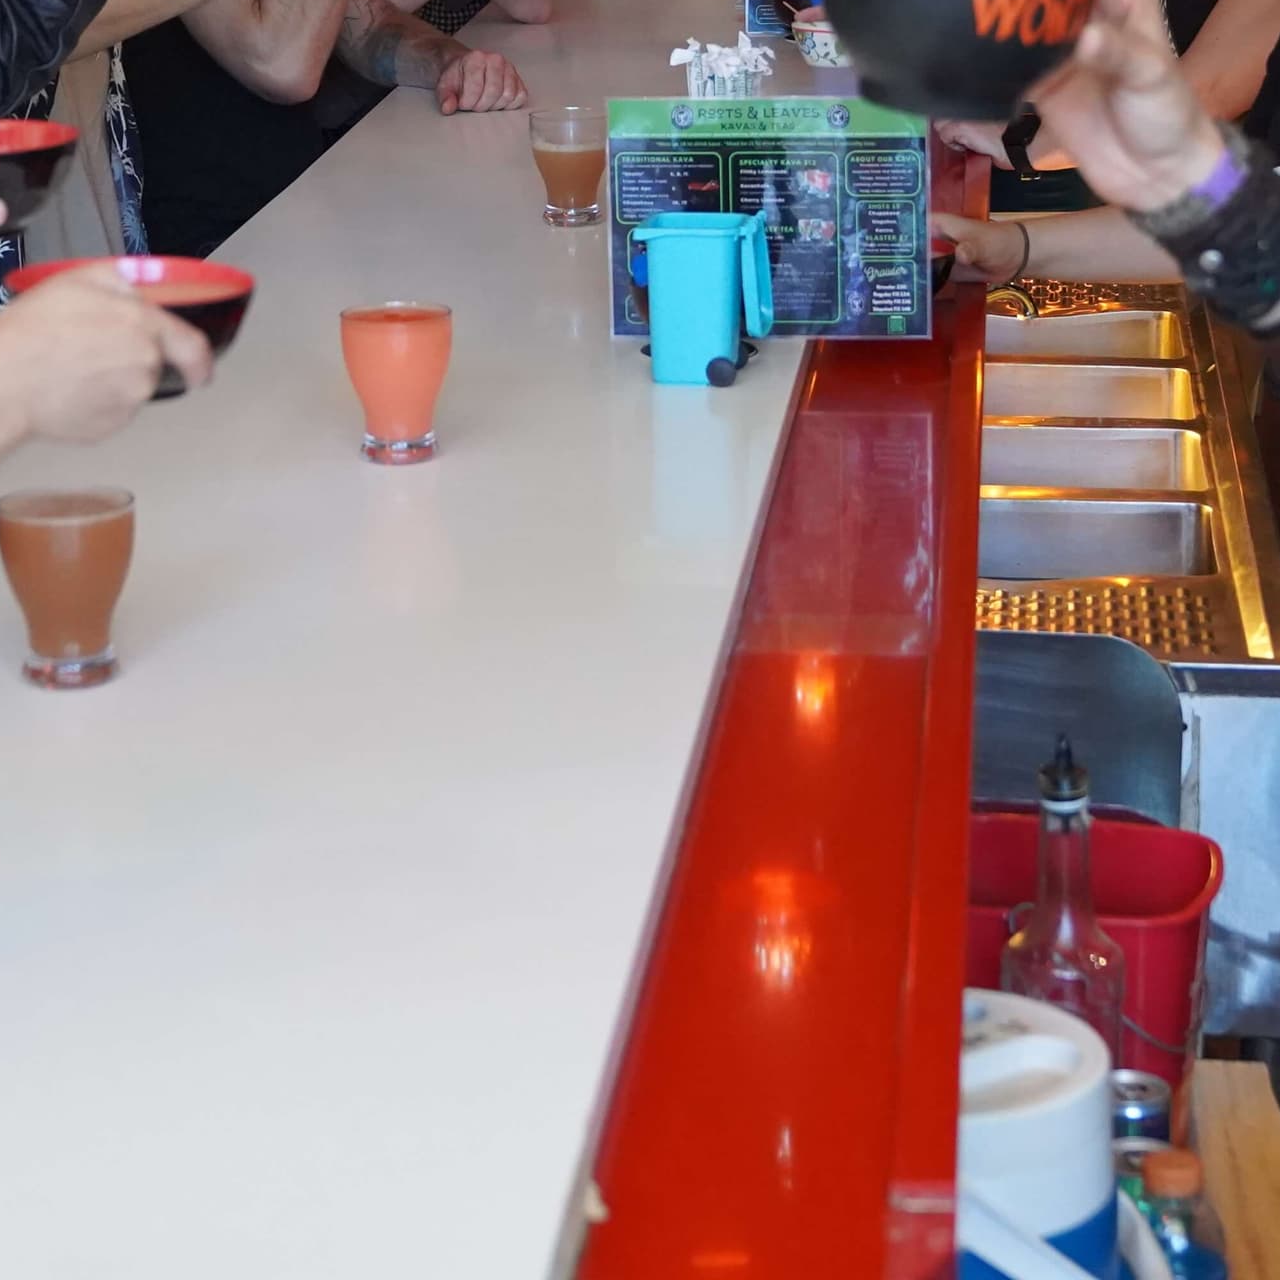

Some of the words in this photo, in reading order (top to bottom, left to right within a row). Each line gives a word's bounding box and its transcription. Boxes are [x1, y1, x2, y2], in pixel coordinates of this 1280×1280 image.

[698, 108, 742, 119] ROOTS
[747, 106, 758, 120] &
[763, 107, 820, 119] LEAVES
